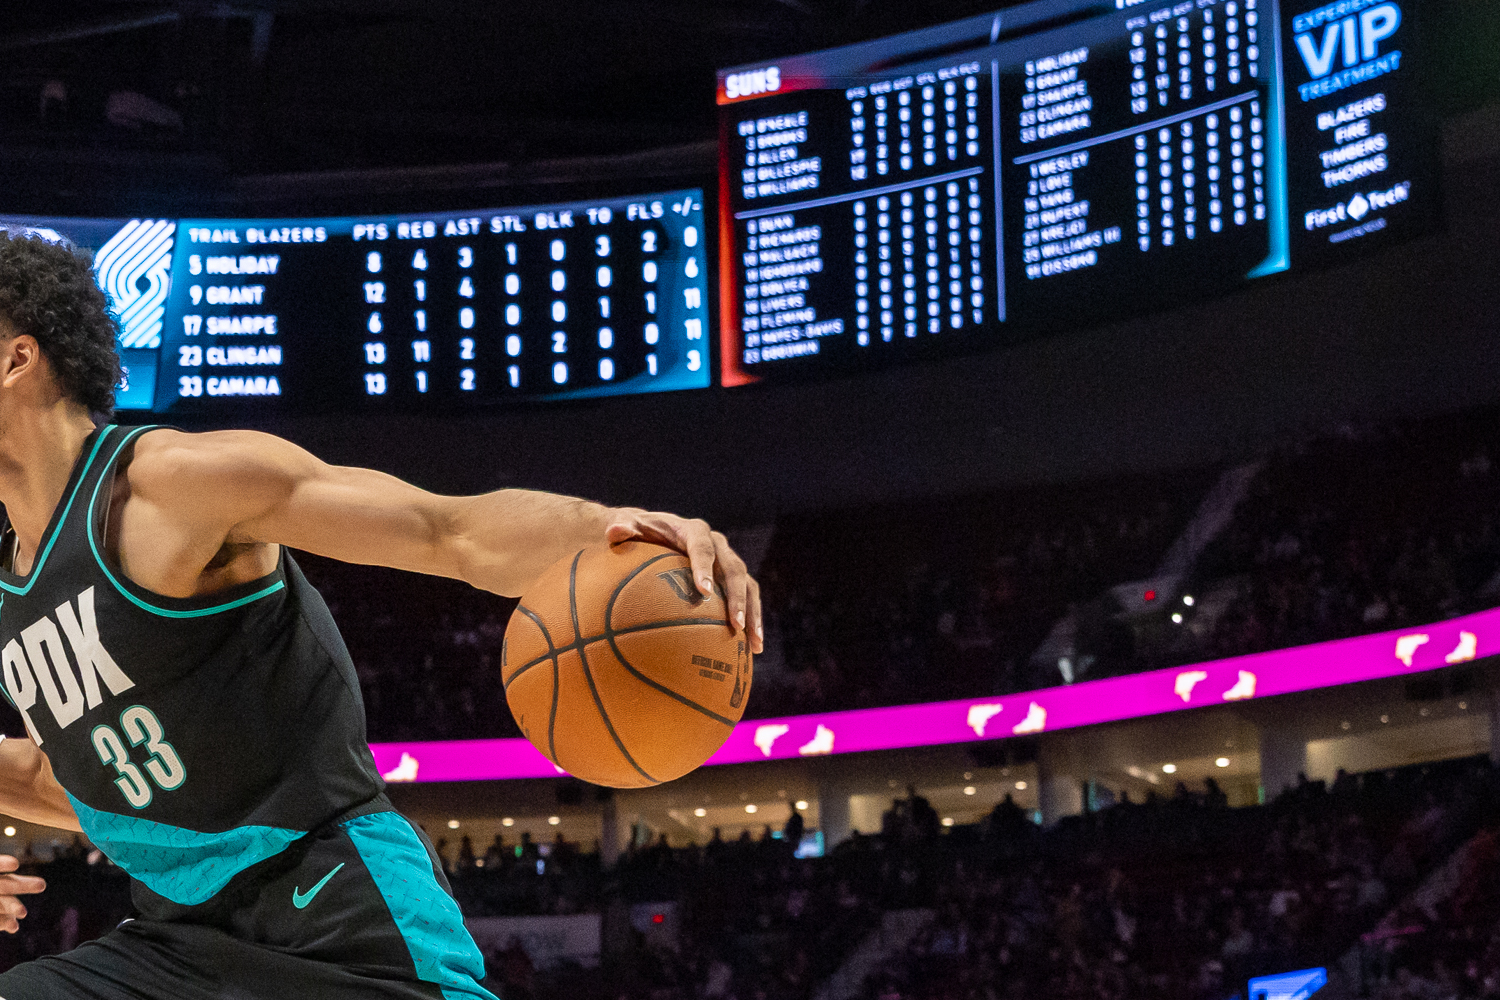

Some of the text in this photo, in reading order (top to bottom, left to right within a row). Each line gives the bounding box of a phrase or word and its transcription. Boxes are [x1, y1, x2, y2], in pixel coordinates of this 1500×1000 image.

[1295, 1, 1401, 80] VIP
[725, 66, 781, 99] SUNS
[1297, 50, 1402, 102] TREATMENT
[1316, 93, 1387, 131] BLAZERS
[1334, 118, 1370, 145] FIRE
[1319, 133, 1388, 169] TIMBERS
[1320, 152, 1388, 188] THORNS
[188, 201, 664, 244] TRAIL BLAZERS PTS REB AST STL BLK TO FLS
[188, 226, 698, 276] 5 HOLIDAY 4 3 1 0 3 2 0
[189, 256, 699, 306] 9 GRANT 12 1 4 0 0 0 0 6
[182, 287, 701, 336] 17 SHARPE 6 1 0 0 0 1 1 11
[179, 318, 702, 367] 23 CLINGAN 13 11 2 0 2 0 0 11
[179, 349, 702, 397] 33 CAMARA 13 1 2 1 0 0 1 3
[91, 704, 187, 810] 33
